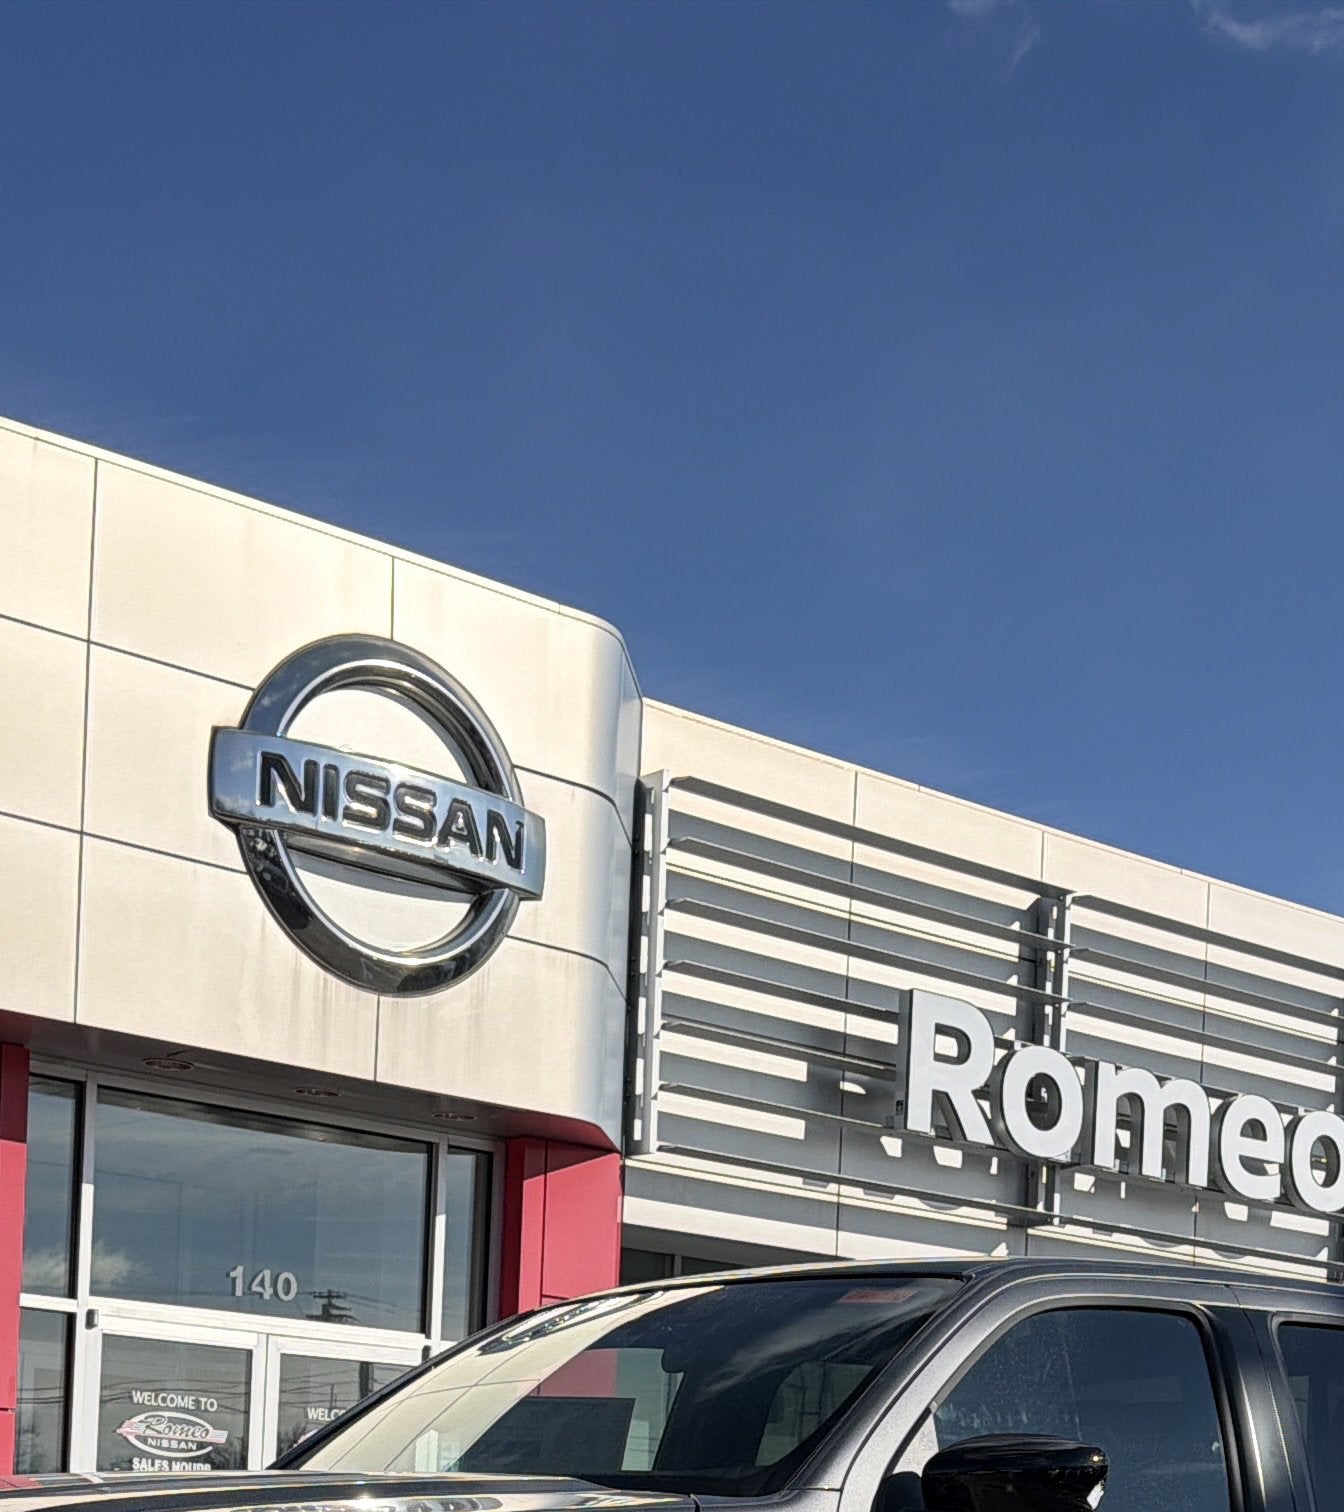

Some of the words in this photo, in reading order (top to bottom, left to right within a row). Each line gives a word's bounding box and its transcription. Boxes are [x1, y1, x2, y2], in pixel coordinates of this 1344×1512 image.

[256, 749, 527, 875] NISSAN
[229, 1265, 298, 1302] 140
[132, 1389, 196, 1410] WELCOME
[199, 1397, 218, 1412] TO
[307, 1406, 346, 1421] WELC
[143, 1414, 210, 1439] Romeo
[147, 1438, 197, 1451] NISSAN
